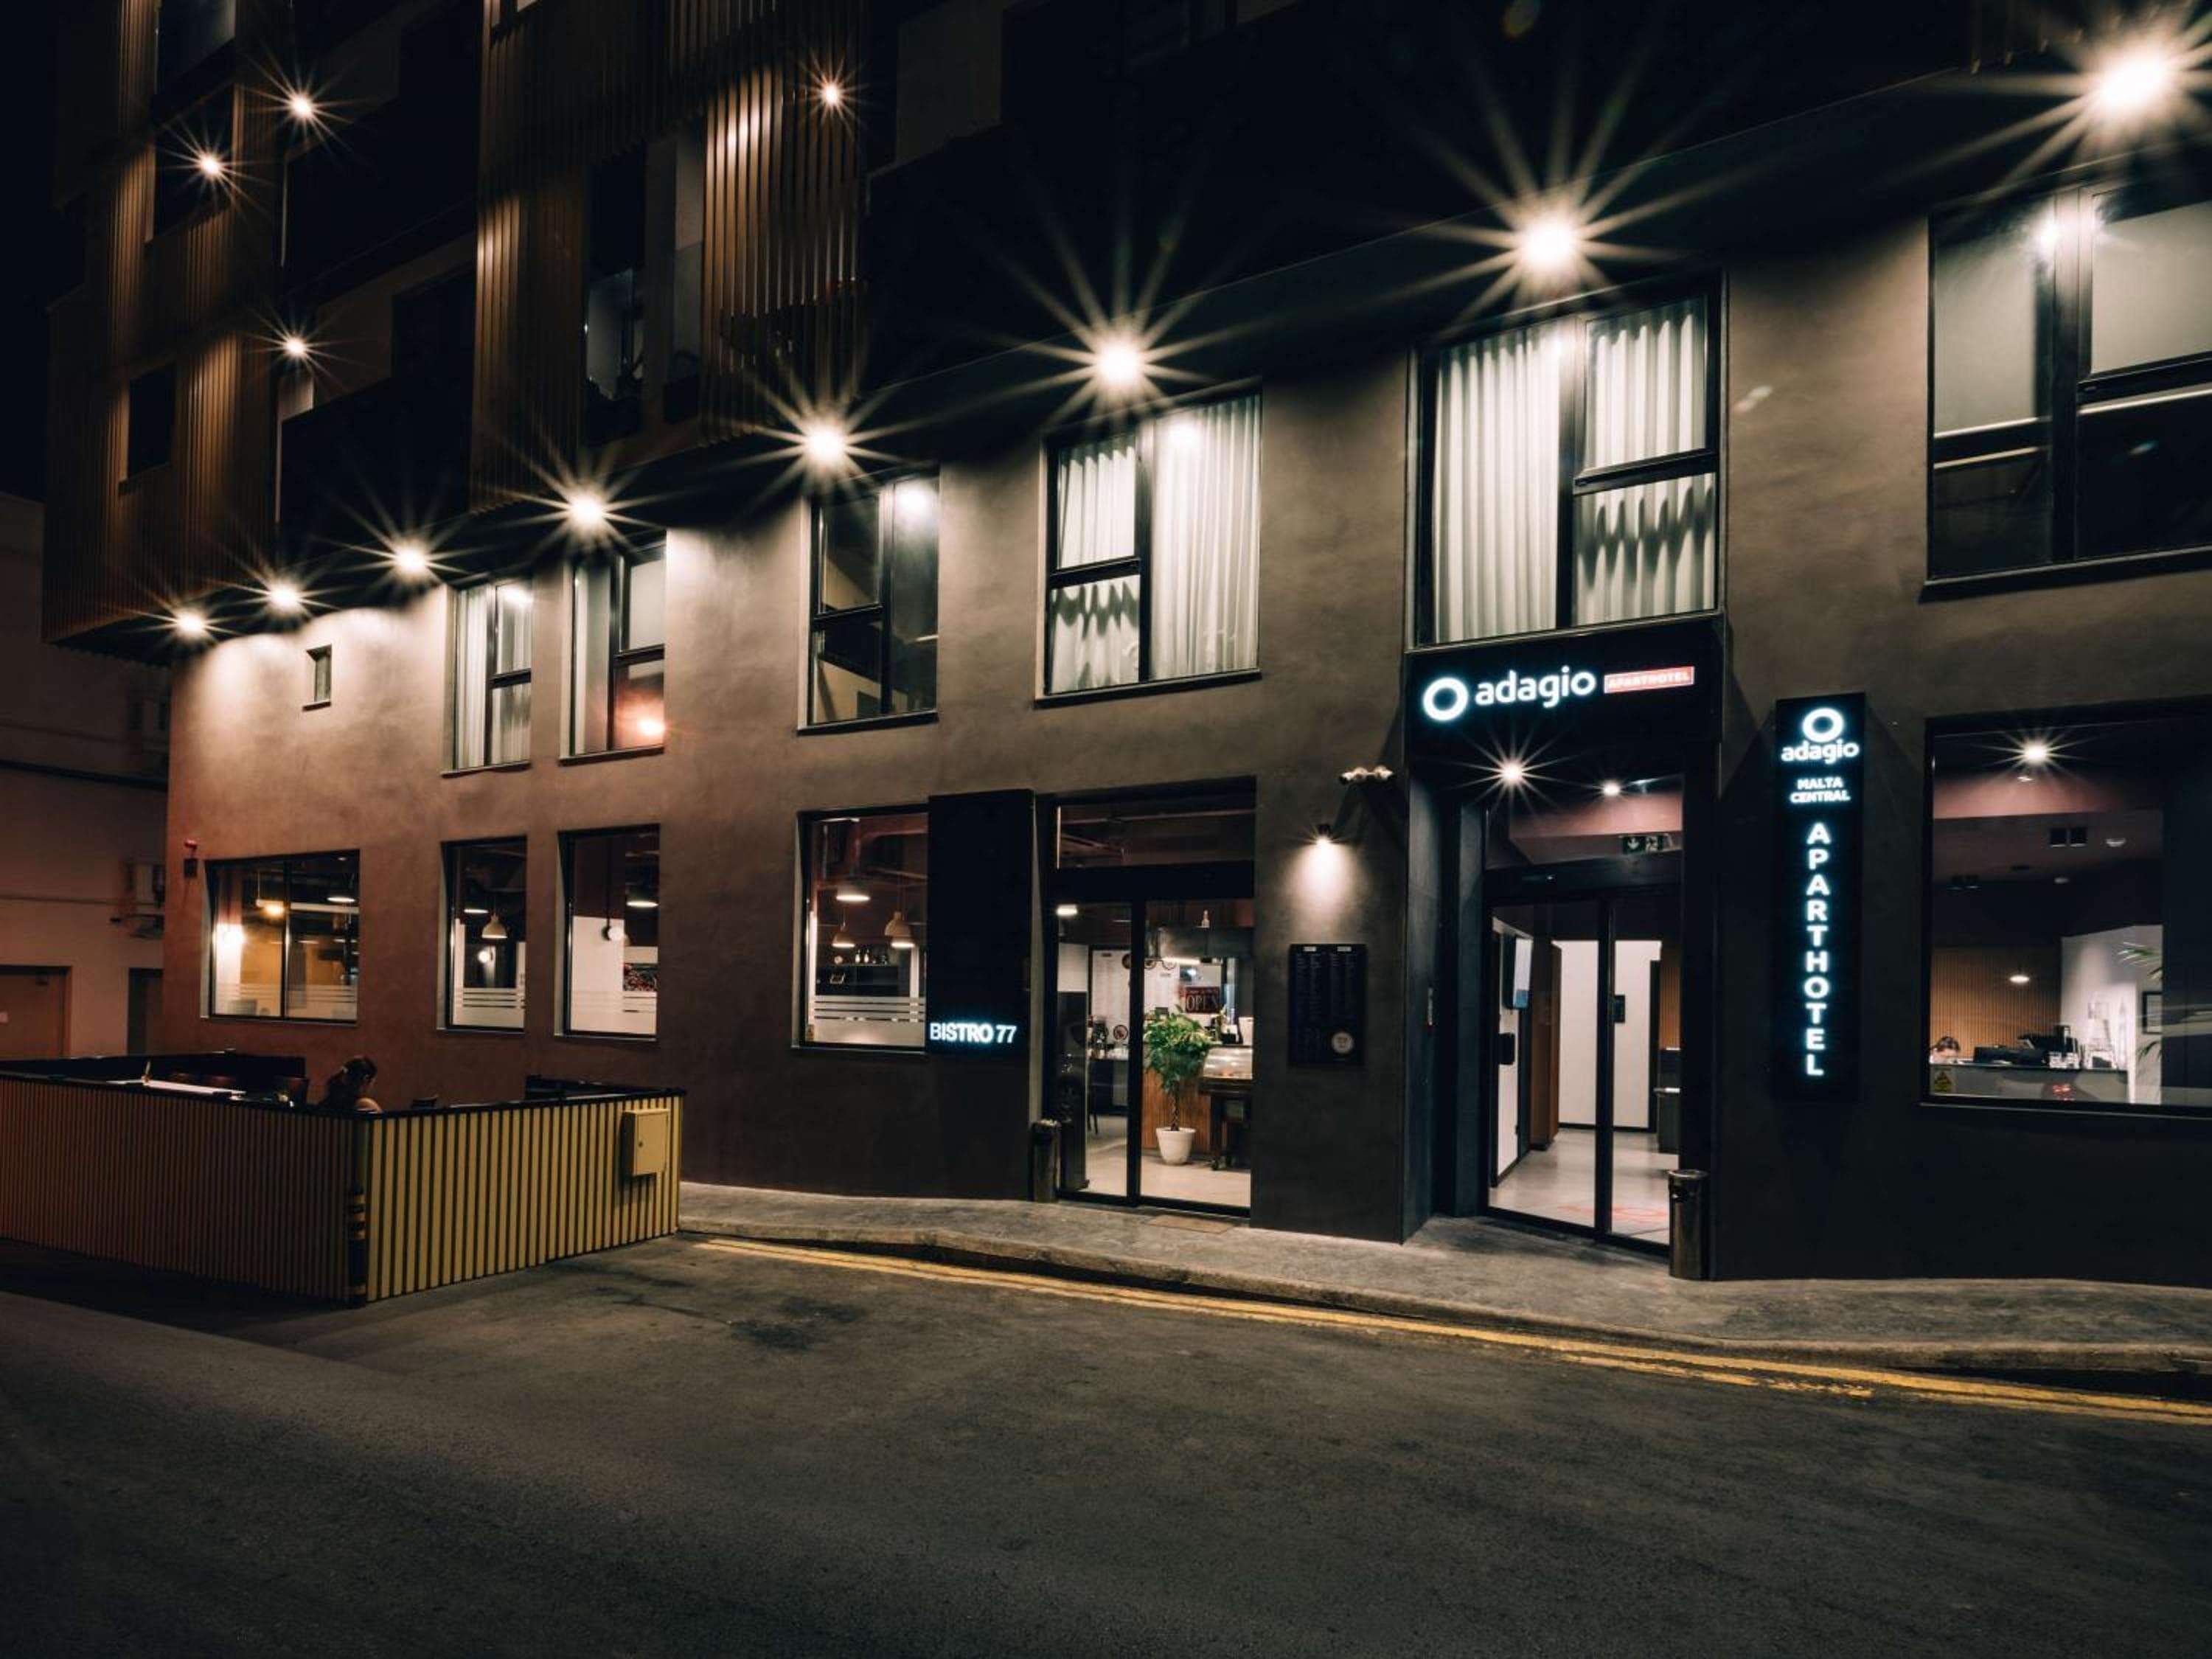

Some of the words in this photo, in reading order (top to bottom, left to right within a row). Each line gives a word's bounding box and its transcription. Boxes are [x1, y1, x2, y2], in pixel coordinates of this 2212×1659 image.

[1475, 666, 1596, 708] adagio
[1781, 739, 1860, 764] adagio
[1797, 776, 1843, 790] MALTA
[1790, 790, 1850, 803] CENTRAL
[1804, 822, 1831, 1076] APARTHOTEL
[1186, 995, 1219, 1011] OPEN
[930, 1023, 994, 1043] BISTRO
[996, 1025, 1017, 1043] 77
